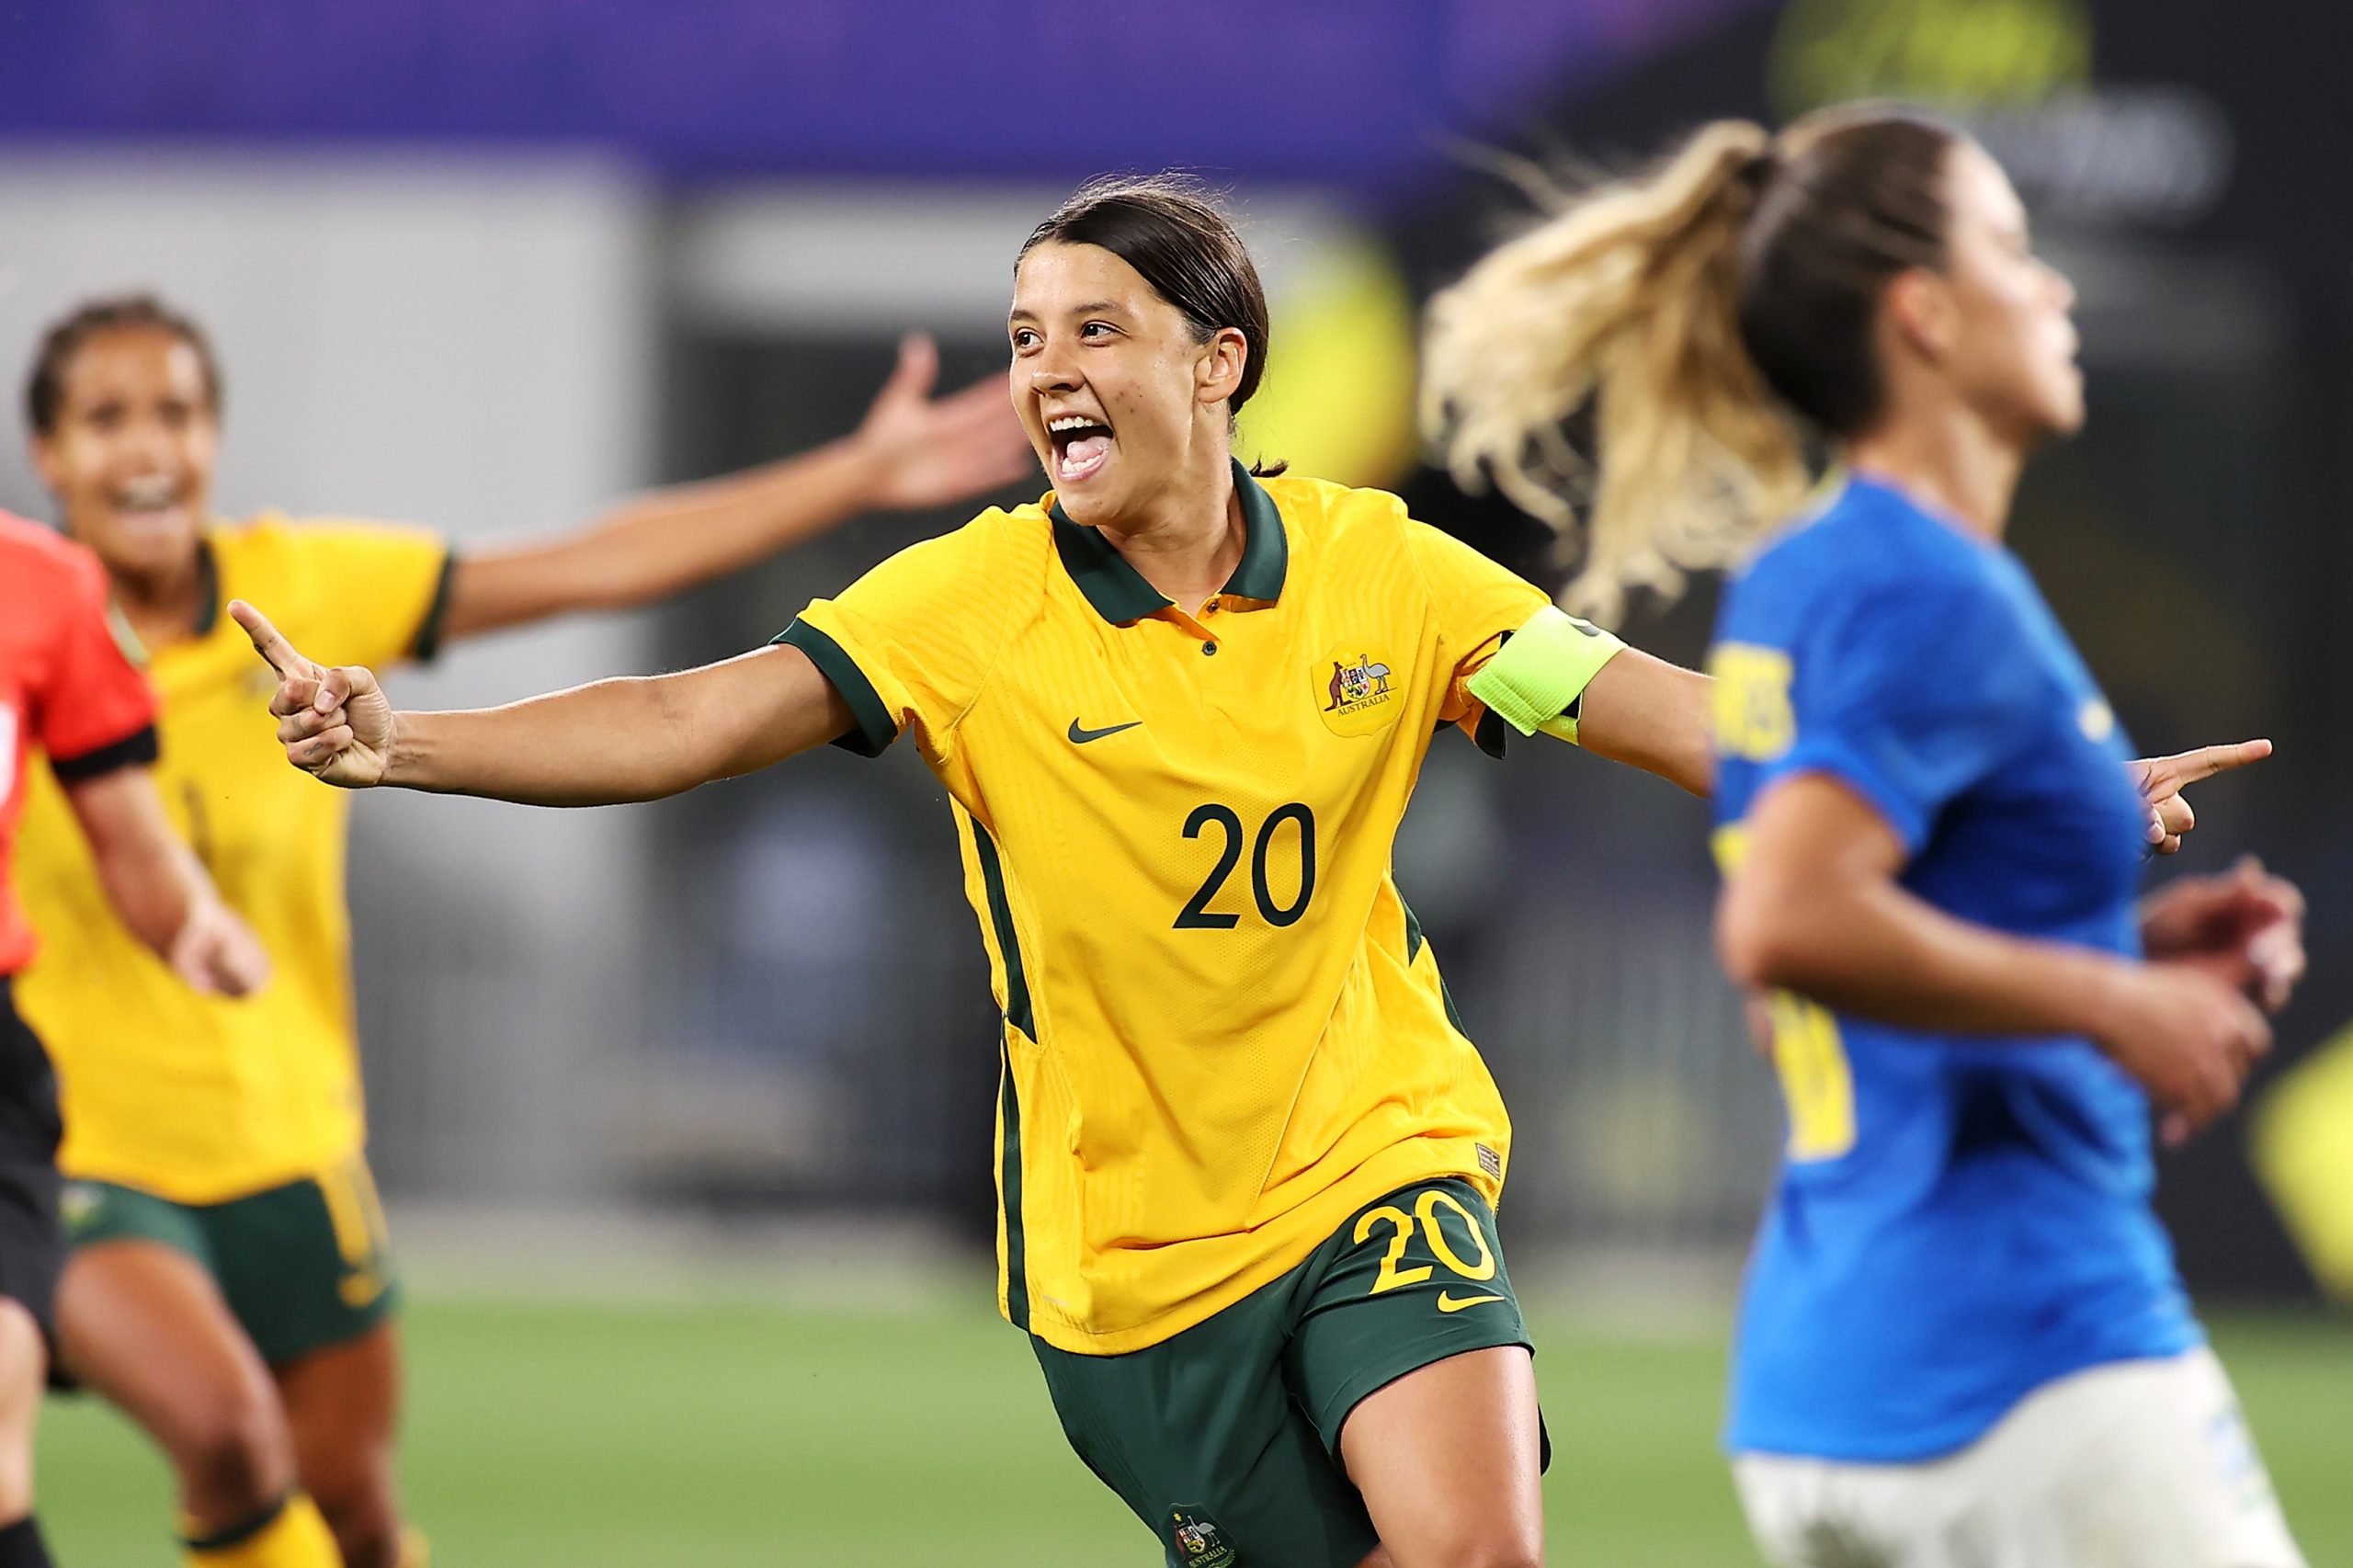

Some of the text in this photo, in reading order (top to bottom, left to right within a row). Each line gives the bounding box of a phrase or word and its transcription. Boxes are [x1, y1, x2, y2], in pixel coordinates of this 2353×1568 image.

[1337, 694, 1390, 717] AUSTRALIA
[1172, 802, 1315, 928] 20
[1353, 1190, 1495, 1294] 20
